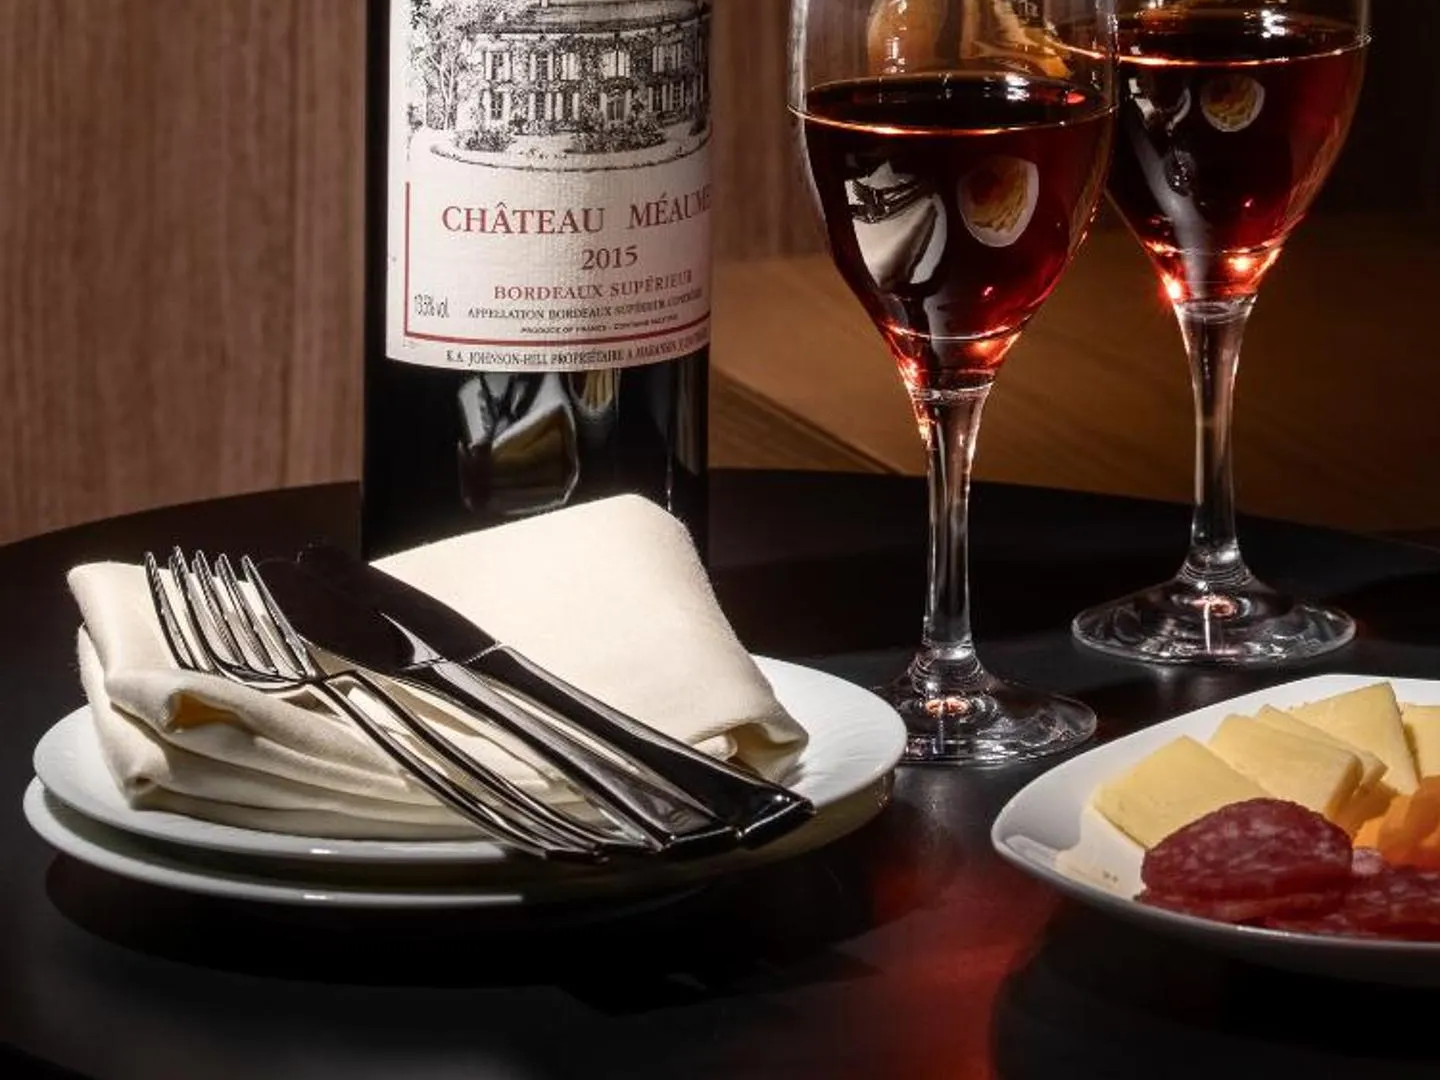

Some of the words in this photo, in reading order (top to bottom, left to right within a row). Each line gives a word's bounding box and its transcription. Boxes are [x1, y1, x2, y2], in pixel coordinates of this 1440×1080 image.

[441, 201, 605, 235] CHÂTEAU
[581, 244, 638, 271] 2015
[493, 284, 604, 300] BORDEAUX
[467, 307, 544, 320] APPELLATION
[548, 305, 612, 320] BORDEAUX
[562, 326, 573, 334] OF
